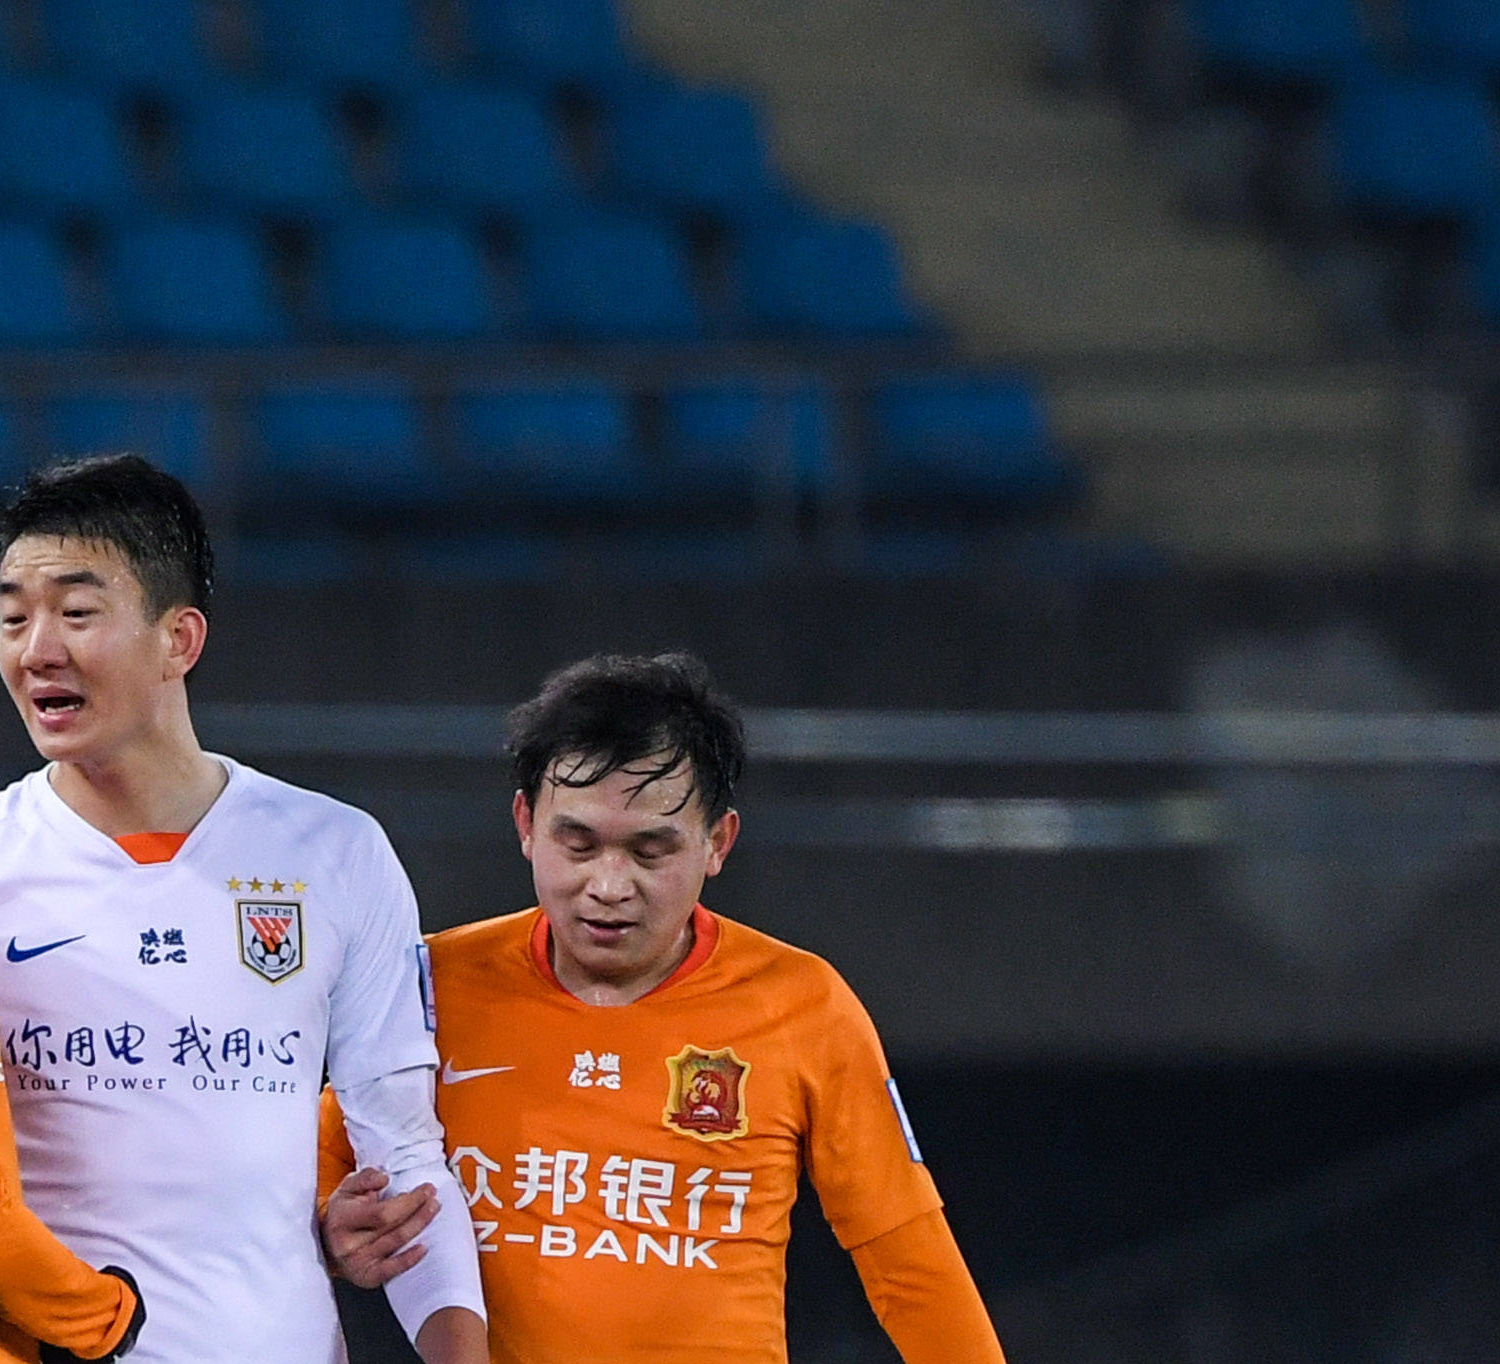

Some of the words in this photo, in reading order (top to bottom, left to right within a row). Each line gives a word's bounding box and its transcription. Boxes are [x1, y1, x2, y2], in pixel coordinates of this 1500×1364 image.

[246, 906, 293, 917] LNTS
[168, 1015, 301, 1073] 我用心
[17, 1075, 71, 1091] Your
[87, 1075, 167, 1091] Power
[192, 1075, 241, 1092] Our
[252, 1076, 297, 1094] Care
[449, 1146, 752, 1234] 众邦银行
[474, 1221, 718, 1269] Z-BANK
